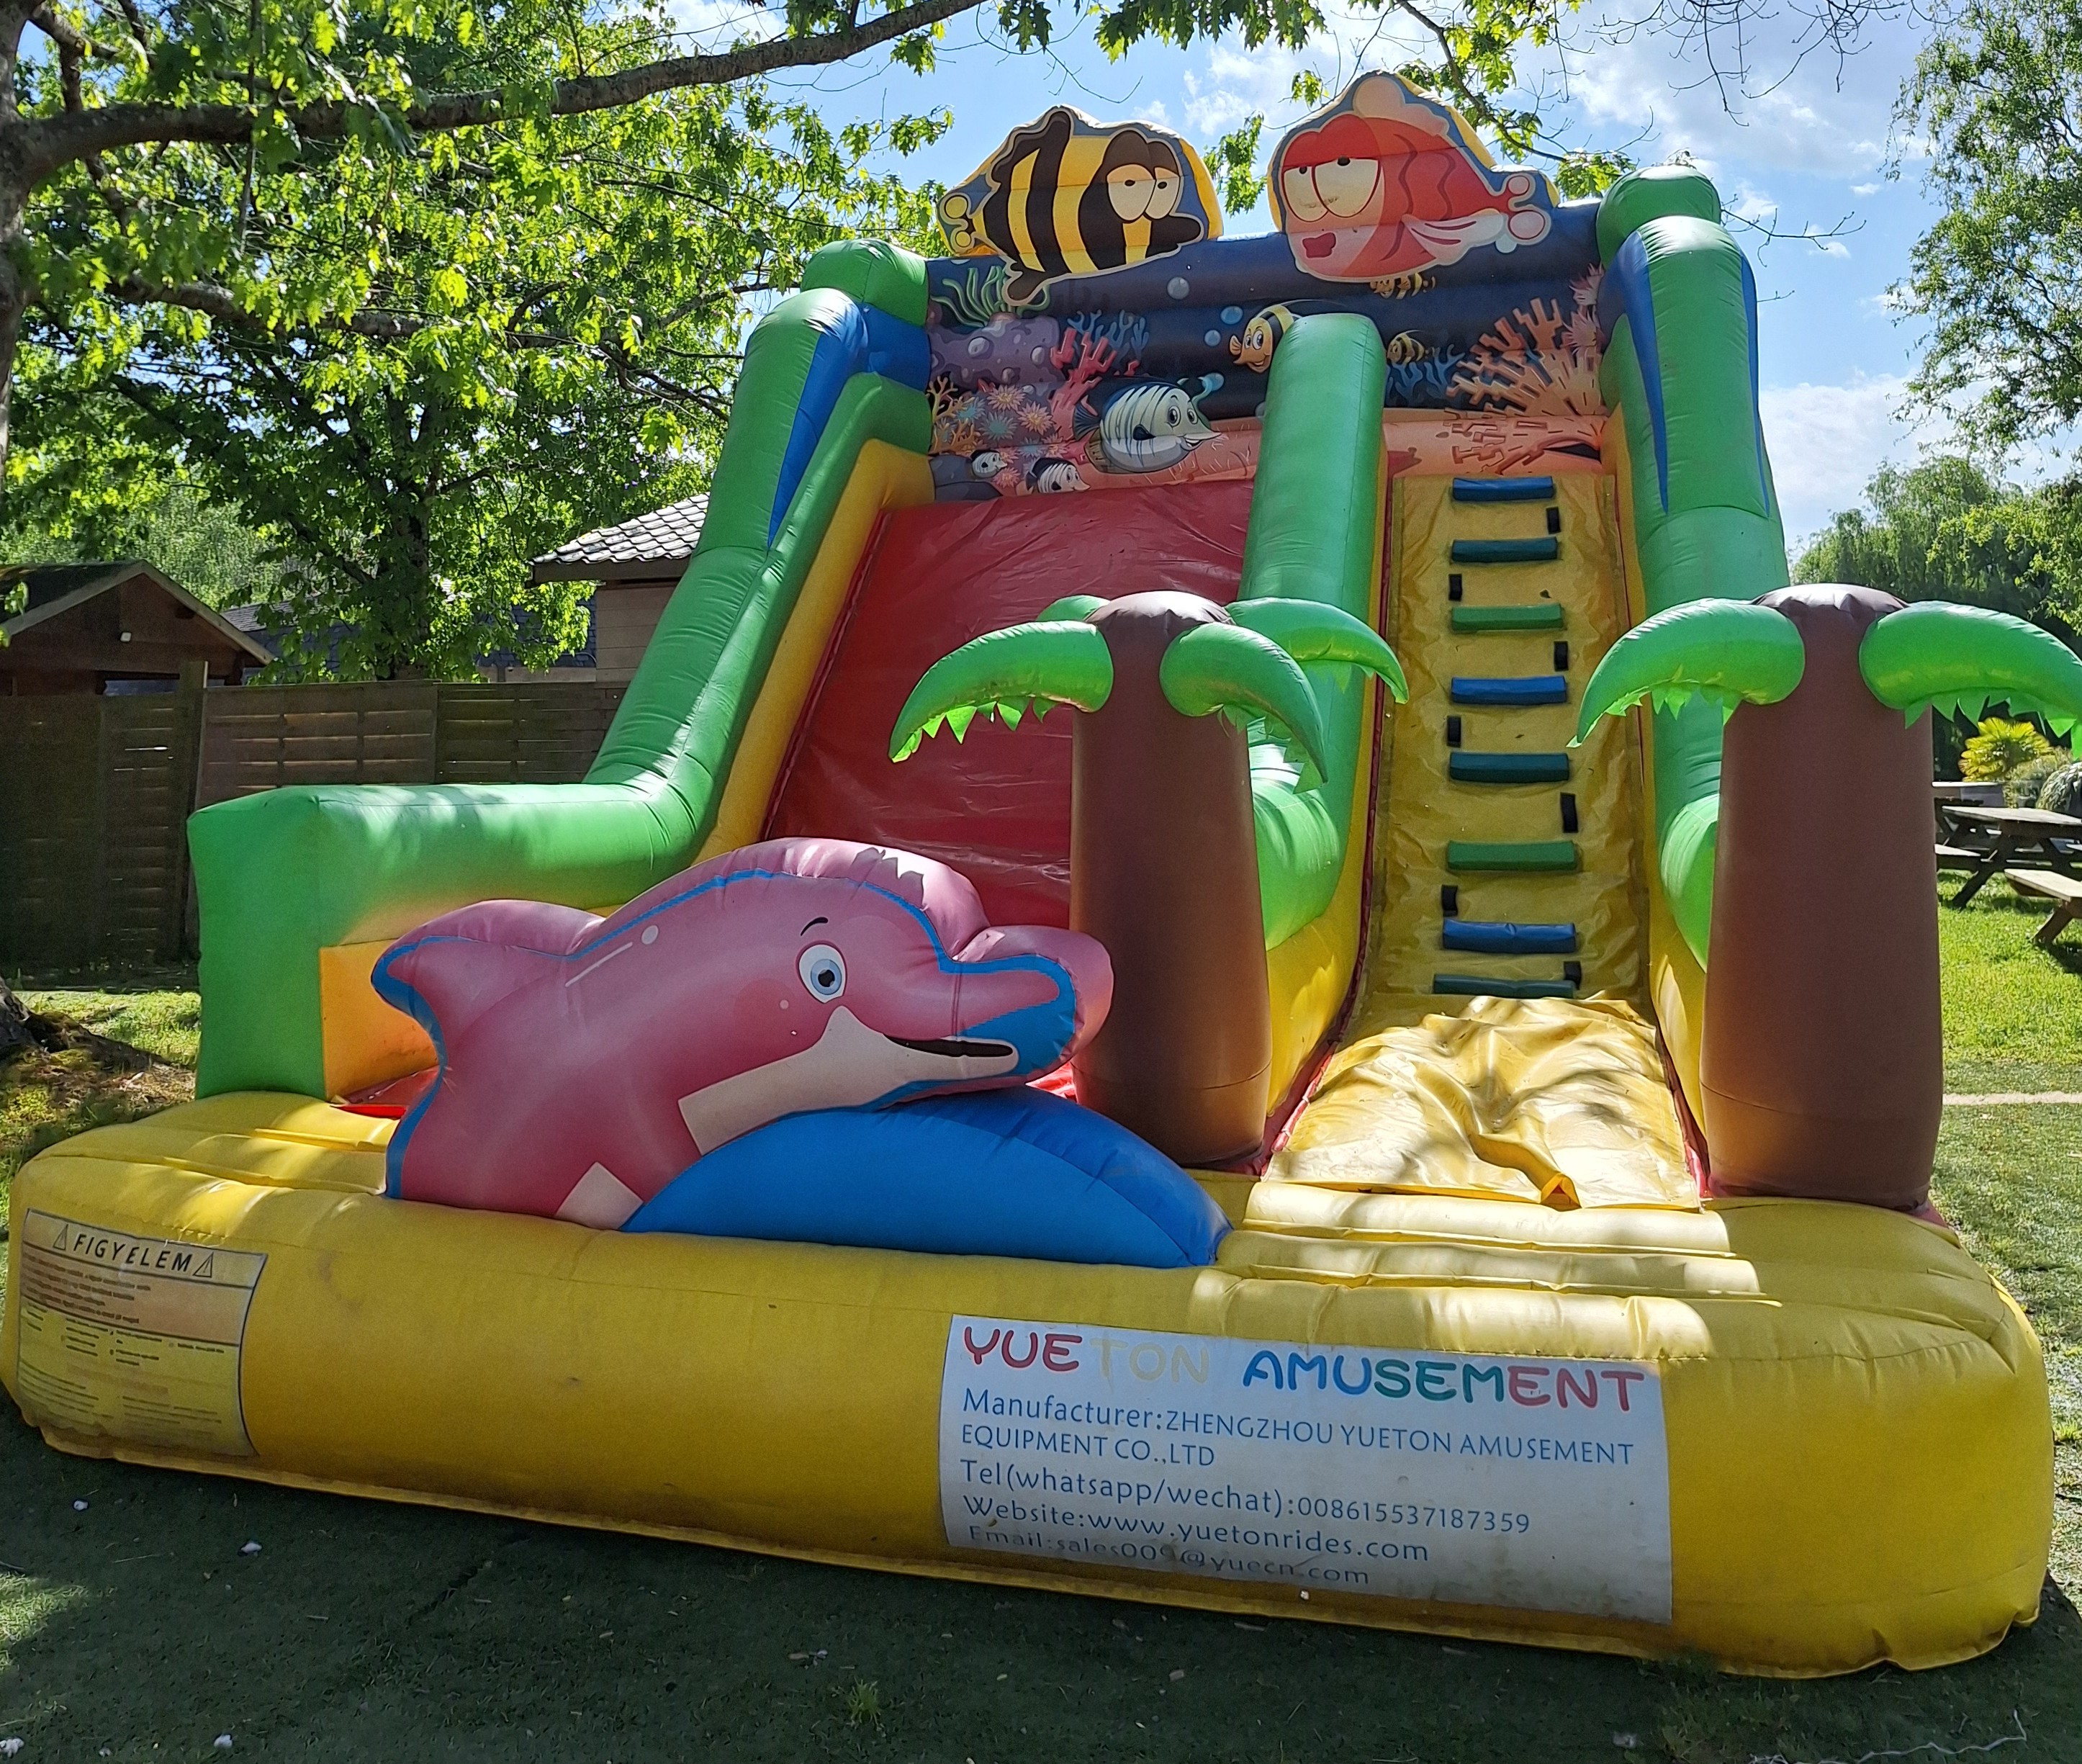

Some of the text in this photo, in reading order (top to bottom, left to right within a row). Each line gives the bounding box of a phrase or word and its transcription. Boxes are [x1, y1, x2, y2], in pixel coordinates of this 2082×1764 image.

[73, 1233, 192, 1273] FIGYELEM
[1243, 1349, 1644, 1412] AMUSEMENT
[961, 1423, 1215, 1467] EQUIPMENT CO.,LTD
[1340, 1423, 1451, 1454] YUETON
[1459, 1434, 1634, 1465] AMUSEMENT
